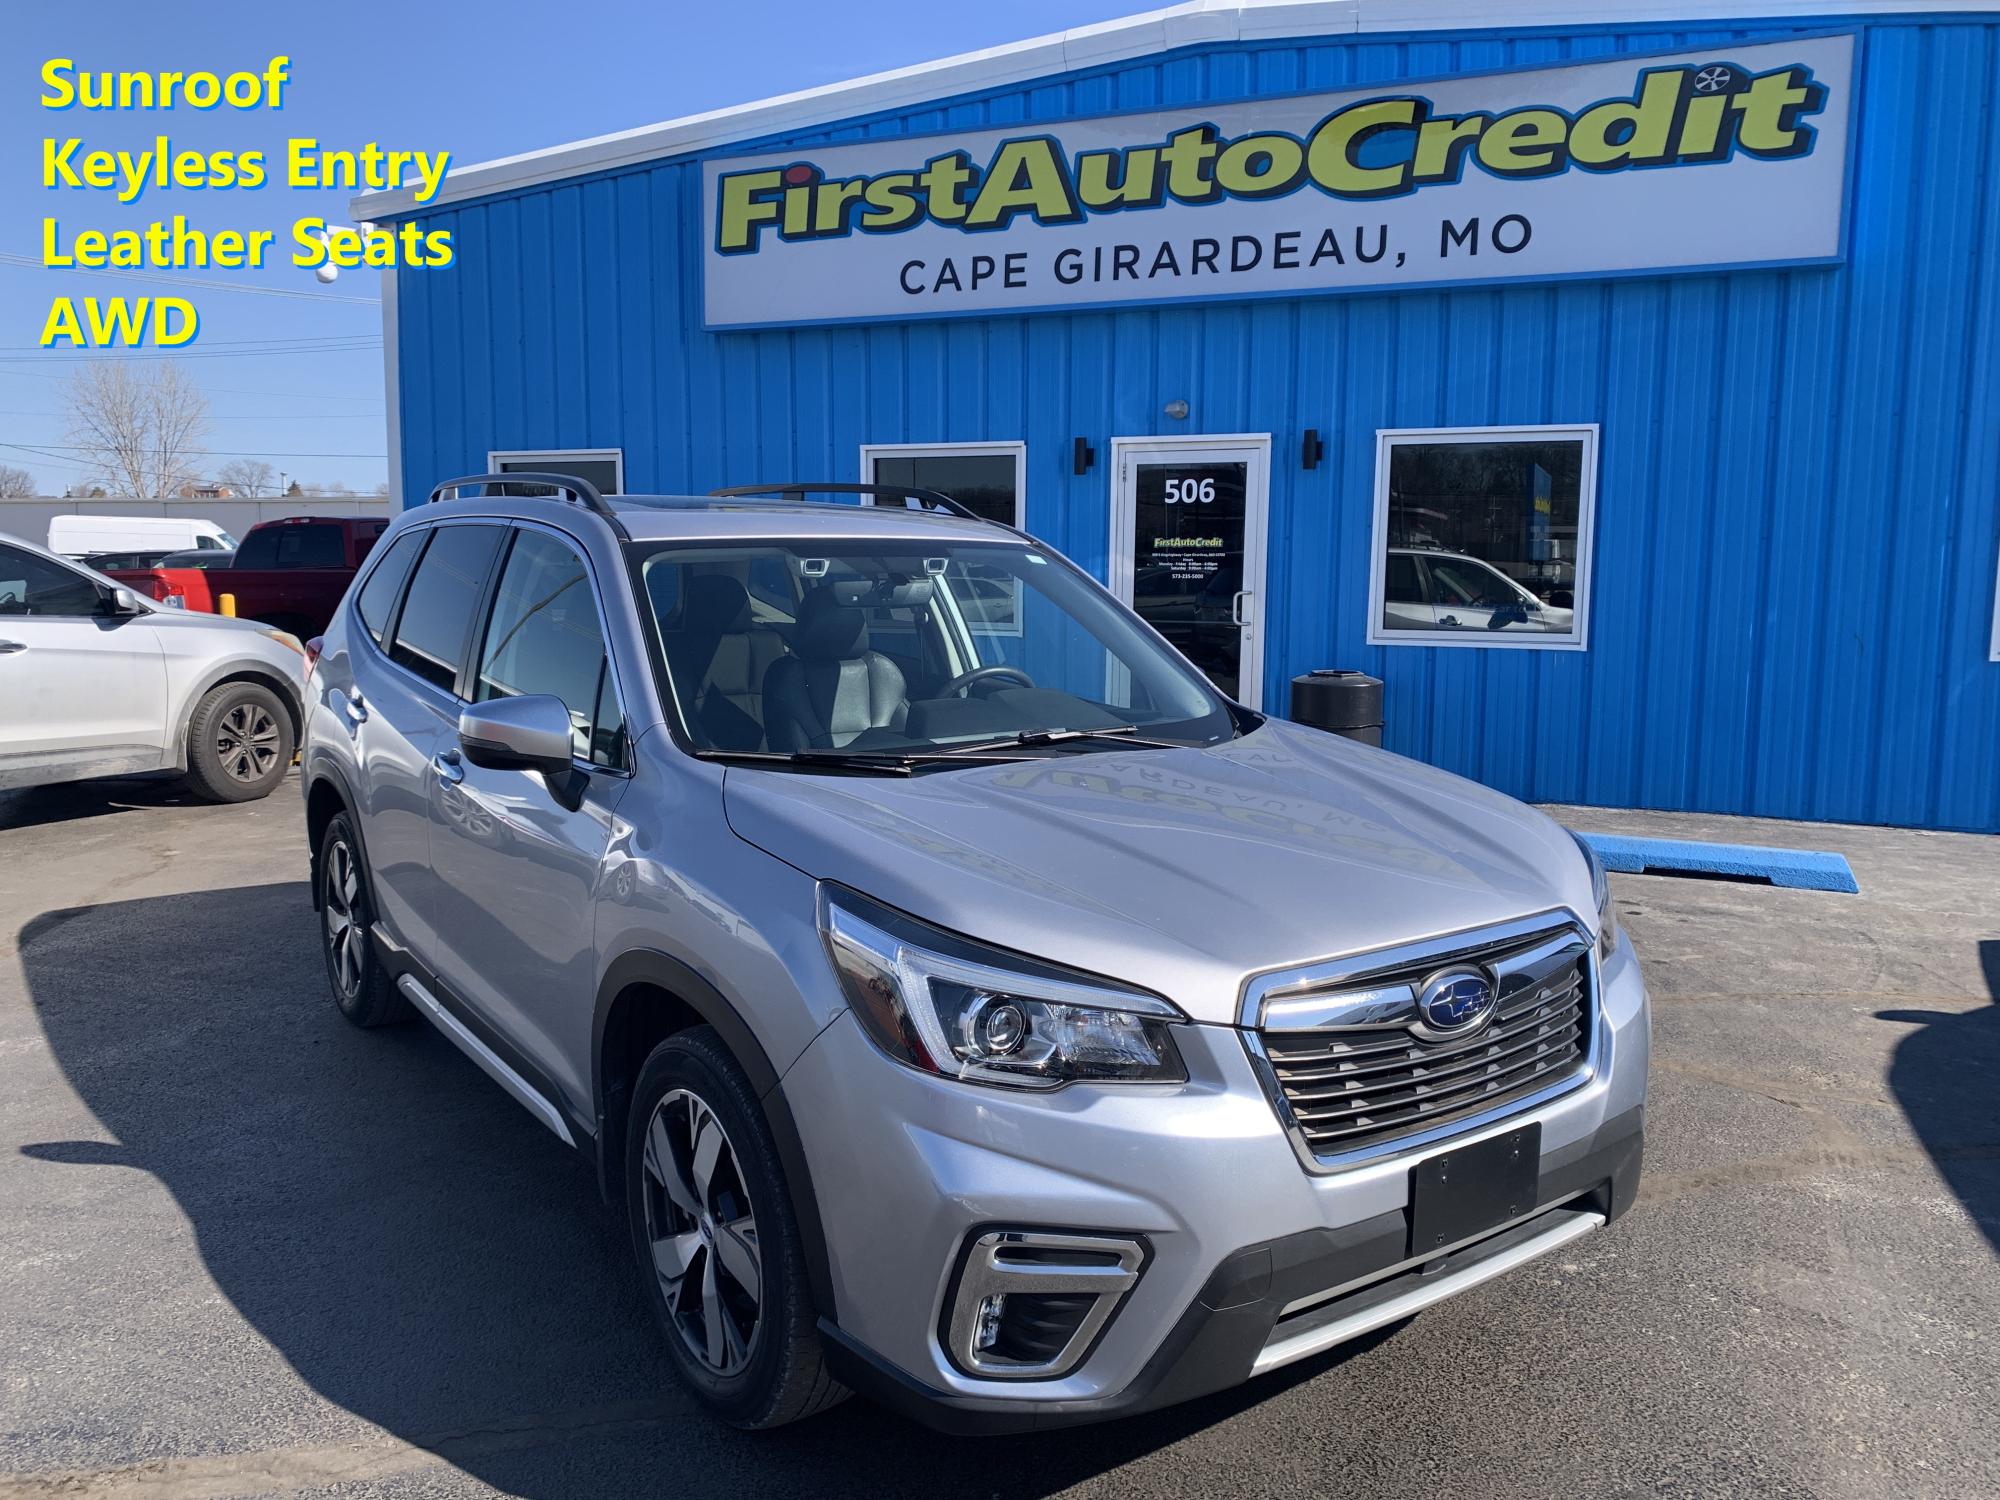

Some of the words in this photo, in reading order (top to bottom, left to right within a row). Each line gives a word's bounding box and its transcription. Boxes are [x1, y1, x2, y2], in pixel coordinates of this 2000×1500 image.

[716, 62, 1829, 255] FirstAutoCredit
[899, 252, 1029, 295] CAPE
[1053, 224, 1406, 286] GIRARDEAU,
[1439, 213, 1533, 258] MO
[1164, 478, 1216, 504] 506
[1154, 537, 1224, 548] FirstAutoCredit
